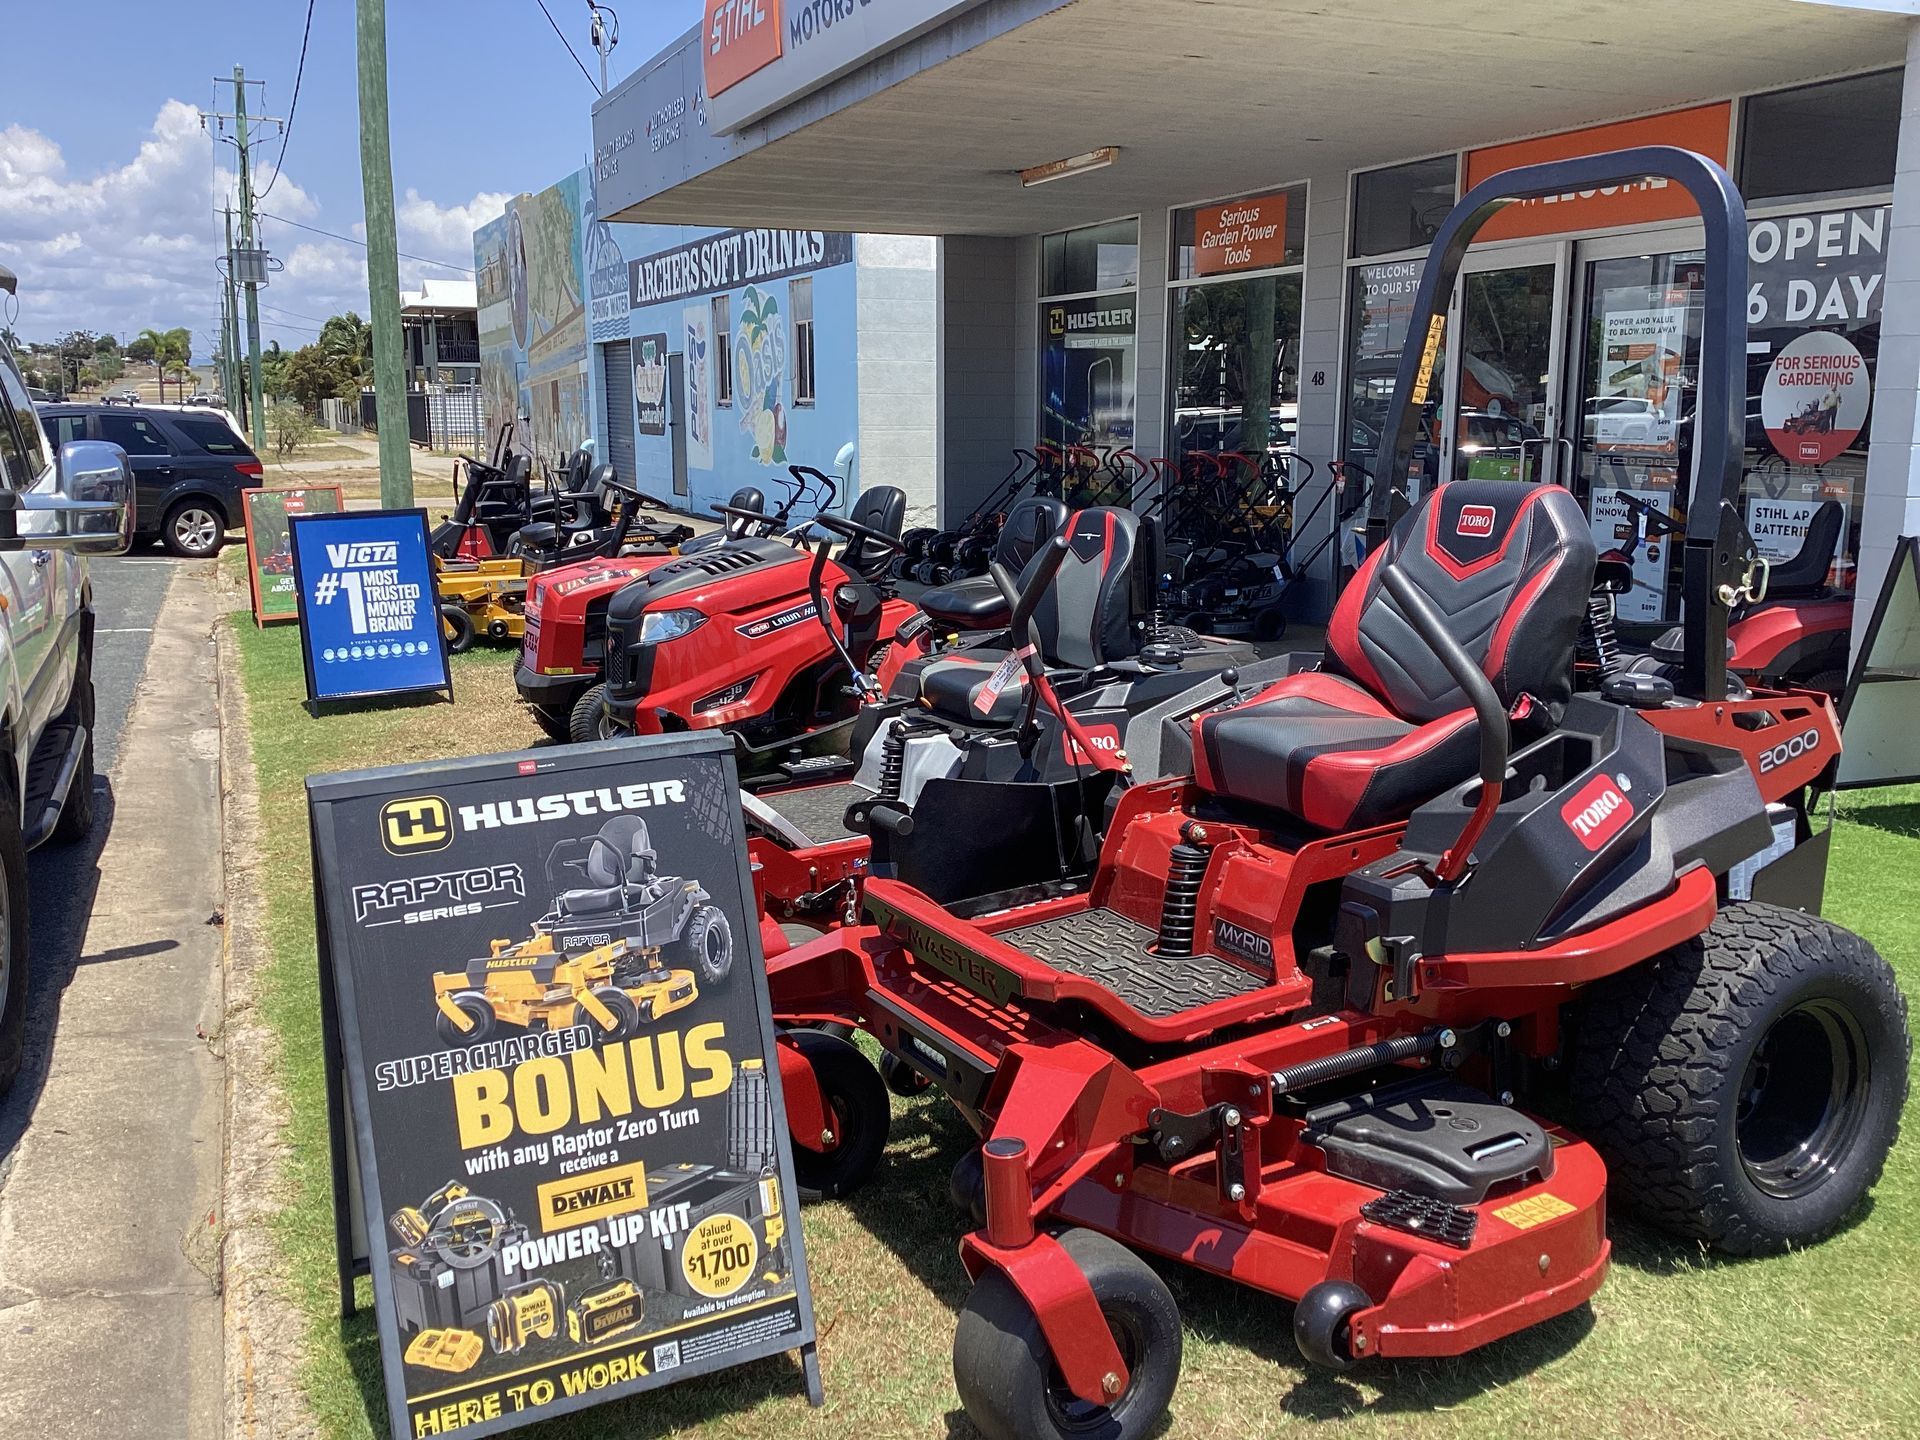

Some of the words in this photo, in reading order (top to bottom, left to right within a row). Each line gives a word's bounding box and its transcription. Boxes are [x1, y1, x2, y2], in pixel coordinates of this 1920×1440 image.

[711, 0, 765, 56] STIHL
[1219, 207, 1260, 228] Serious
[1201, 228, 1239, 248] Garden
[1240, 224, 1277, 242] Power
[1749, 209, 1885, 264] OPEN
[636, 247, 700, 302] ARCHERS
[701, 236, 741, 289] SOFT
[743, 229, 824, 279] DRINKS
[1224, 244, 1252, 265] Tools
[1367, 264, 1416, 279] WELCOME
[1366, 284, 1379, 296] TO
[1381, 282, 1402, 294] OUR
[1747, 282, 1768, 323] 6
[1785, 273, 1882, 321] DAY
[1067, 308, 1133, 330] HUSTLER
[1609, 318, 1633, 326] POWER
[1635, 316, 1650, 325] AND
[1652, 315, 1674, 324] VALUE
[1609, 328, 1618, 336] TO
[1619, 327, 1639, 335] BLOW
[1641, 326, 1656, 334] YOU
[1658, 325, 1676, 334] AWAY
[735, 314, 785, 410] Oasis
[1776, 357, 1800, 370] FOR
[1803, 355, 1860, 370] SERIOUS
[688, 323, 699, 442] PEPSI
[1311, 371, 1325, 386] 48
[1778, 372, 1854, 386] GARDENING
[1461, 514, 1490, 527] TORO
[1755, 507, 1788, 520] STIHL
[1793, 510, 1809, 520] AP
[325, 541, 398, 568] VICTA
[362, 569, 398, 586] MOST
[364, 583, 420, 601] TRUSTED
[366, 599, 417, 618] MOWER
[771, 612, 802, 626] LAWN
[1067, 735, 1117, 754] TRO
[1759, 727, 1820, 774] 2000
[460, 779, 686, 831] HUSTLER
[1572, 788, 1623, 836] TORO
[353, 862, 526, 925] RAPTOR
[403, 901, 483, 924] SERIES
[563, 933, 611, 950] RAPTOR
[1218, 922, 1273, 959] MyRID
[486, 956, 539, 969] HUSTLER
[906, 925, 999, 1000] MASTER
[375, 1025, 593, 1092] SUPERCHARGED
[452, 1021, 734, 1151] BONUS
[464, 1147, 510, 1175] with
[513, 1141, 550, 1165] any
[551, 1123, 614, 1157] Raptor
[615, 1116, 658, 1142] Zero
[658, 1108, 700, 1132] Turn
[559, 1153, 608, 1174] receive
[609, 1149, 619, 1162] a
[502, 1213, 645, 1276] POWER-UP
[650, 1201, 692, 1240] KIT
[699, 1219, 732, 1238] Valued
[701, 1239, 712, 1250] at
[712, 1233, 733, 1248] over
[714, 1276, 731, 1289] RRP
[683, 1302, 716, 1320] Available
[716, 1299, 726, 1311] by
[726, 1288, 766, 1308] redemption
[413, 1391, 502, 1440] HERE
[506, 1380, 555, 1412] TO
[560, 1350, 650, 1397] WORK
